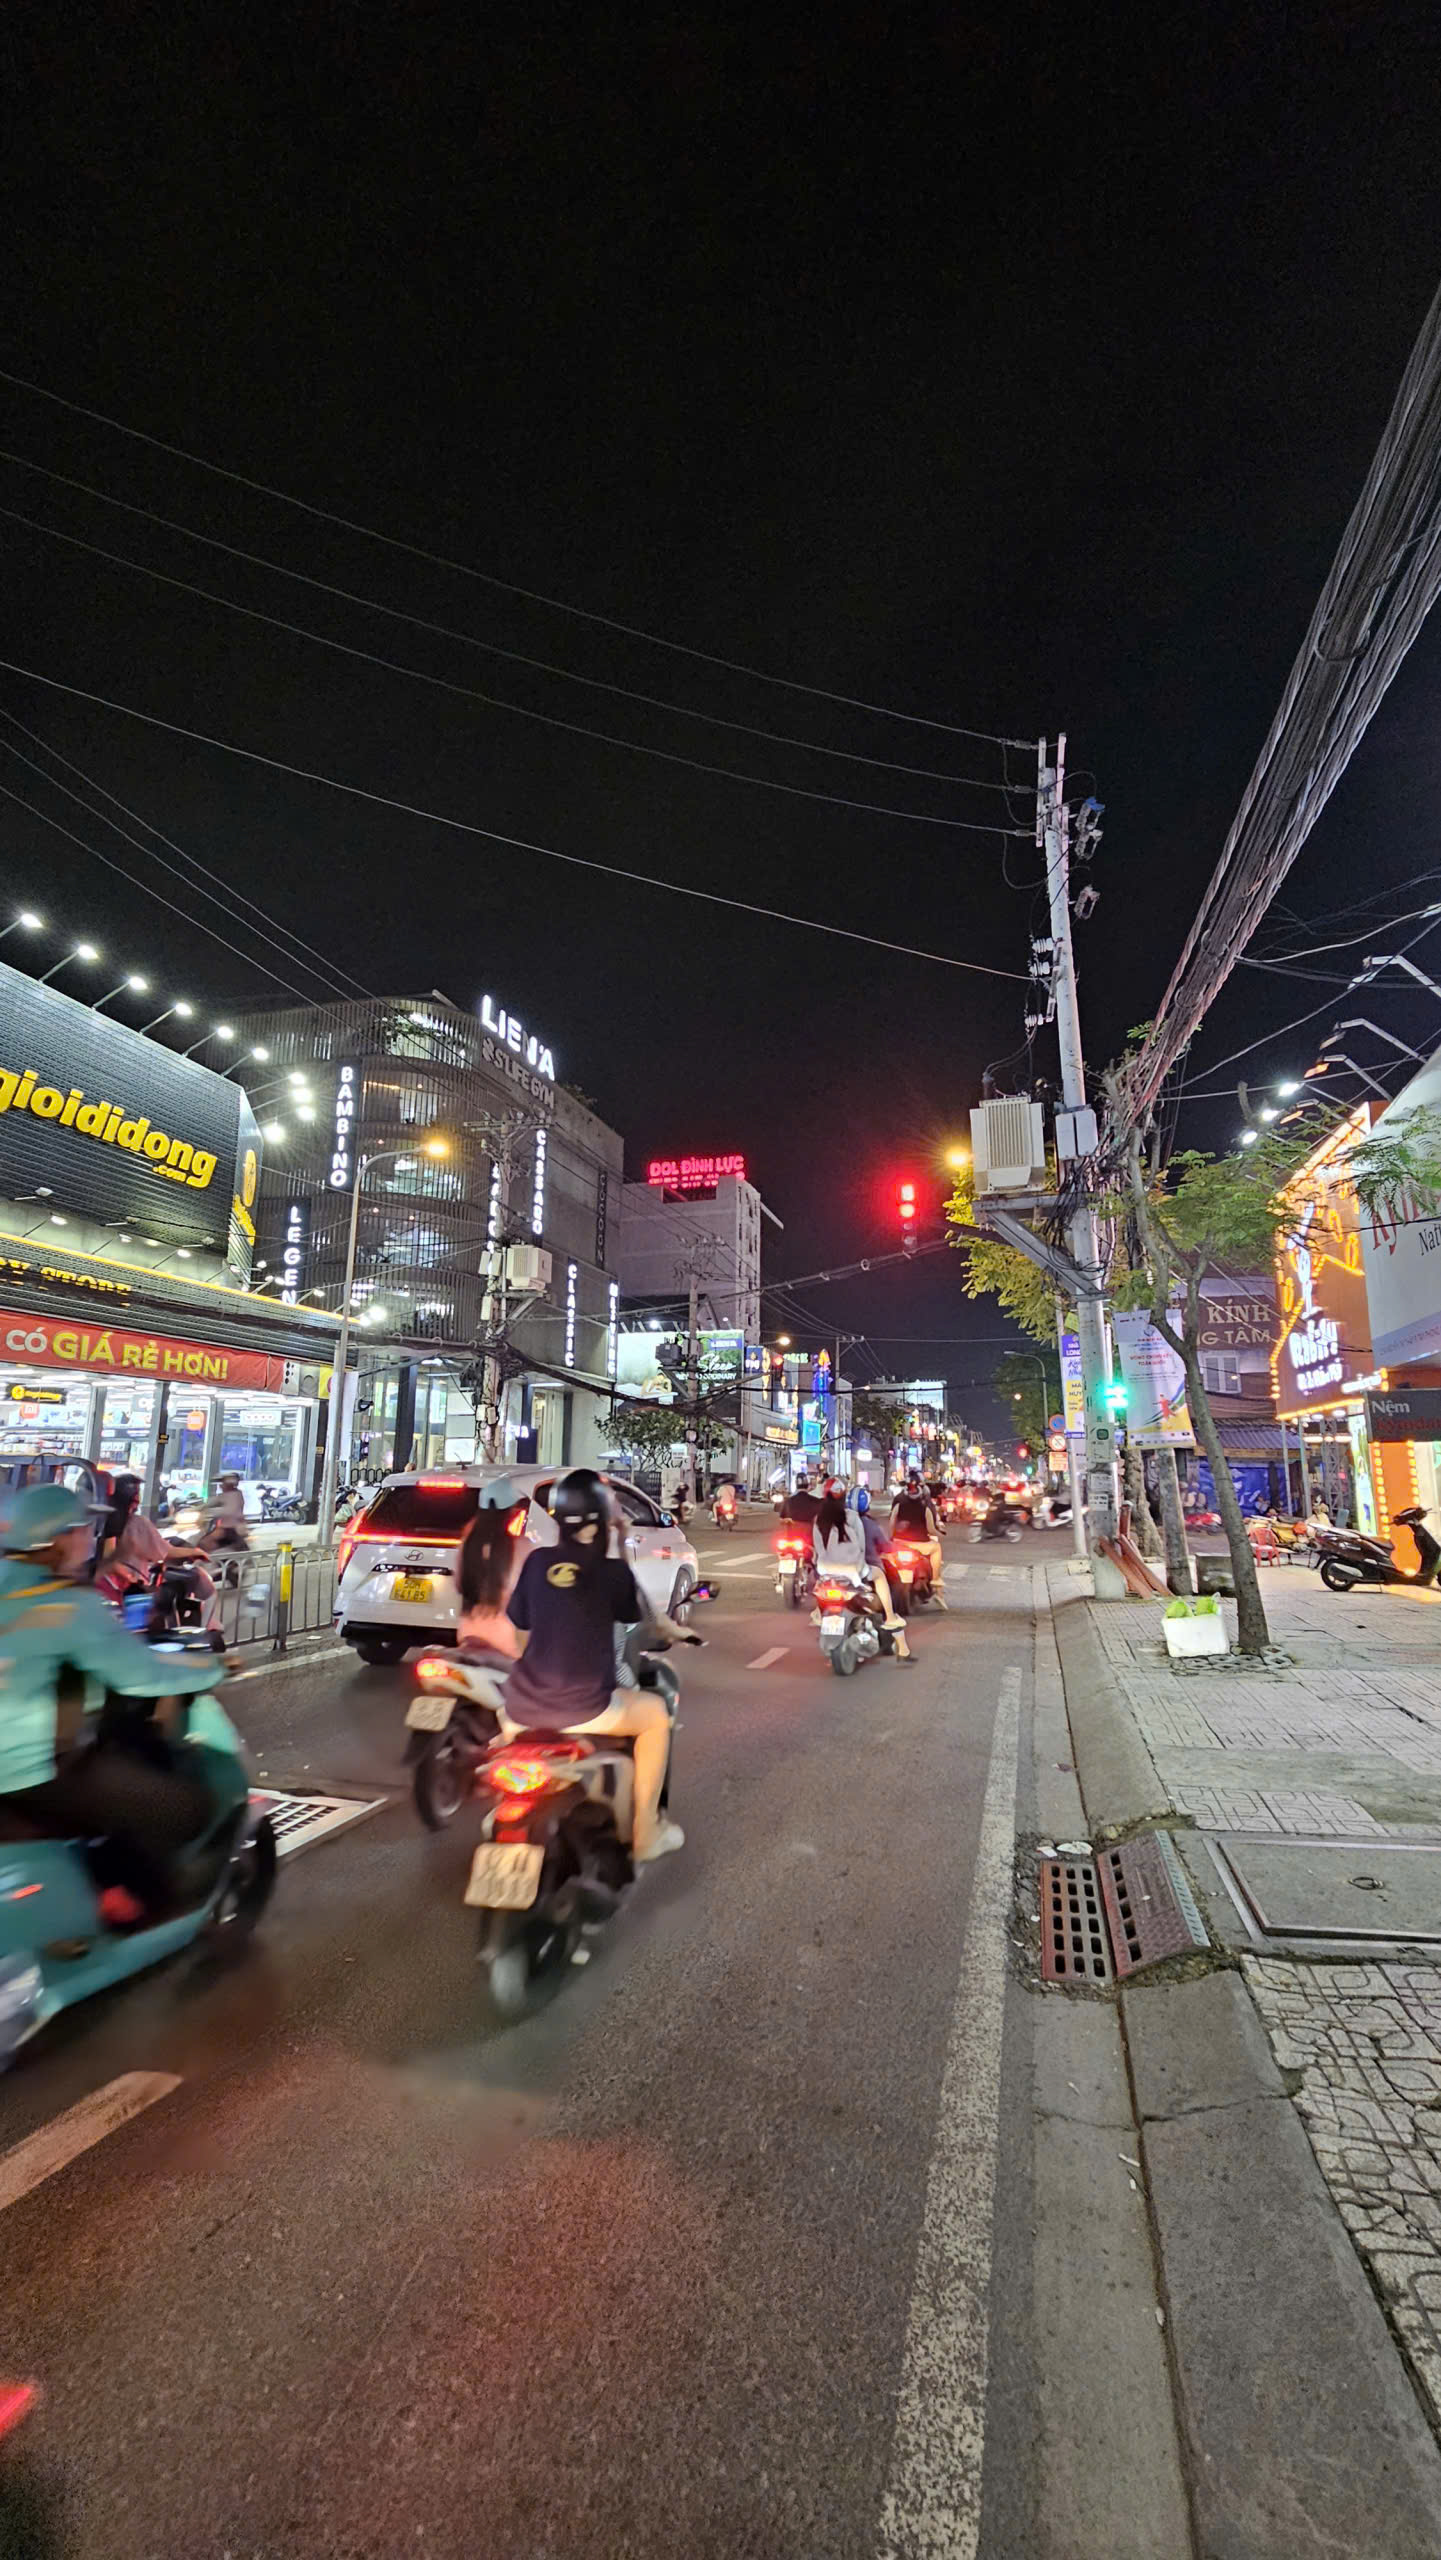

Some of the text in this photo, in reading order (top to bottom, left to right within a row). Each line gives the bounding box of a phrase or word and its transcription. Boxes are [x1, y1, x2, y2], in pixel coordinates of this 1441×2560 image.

[530, 1077, 554, 1109] GYM
[330, 1066, 353, 1187] BAMBINO
[152, 1164, 187, 1182] .com
[649, 1161, 679, 1177] DOL
[681, 1156, 713, 1175] ĐÌNH
[1207, 1298, 1271, 1324] KÍNH
[1223, 1326, 1271, 1345] TÂM
[6, 1327, 229, 1380] CÓ GIÁ RẺ HƠN!
[1371, 1399, 1411, 1417] Nệm
